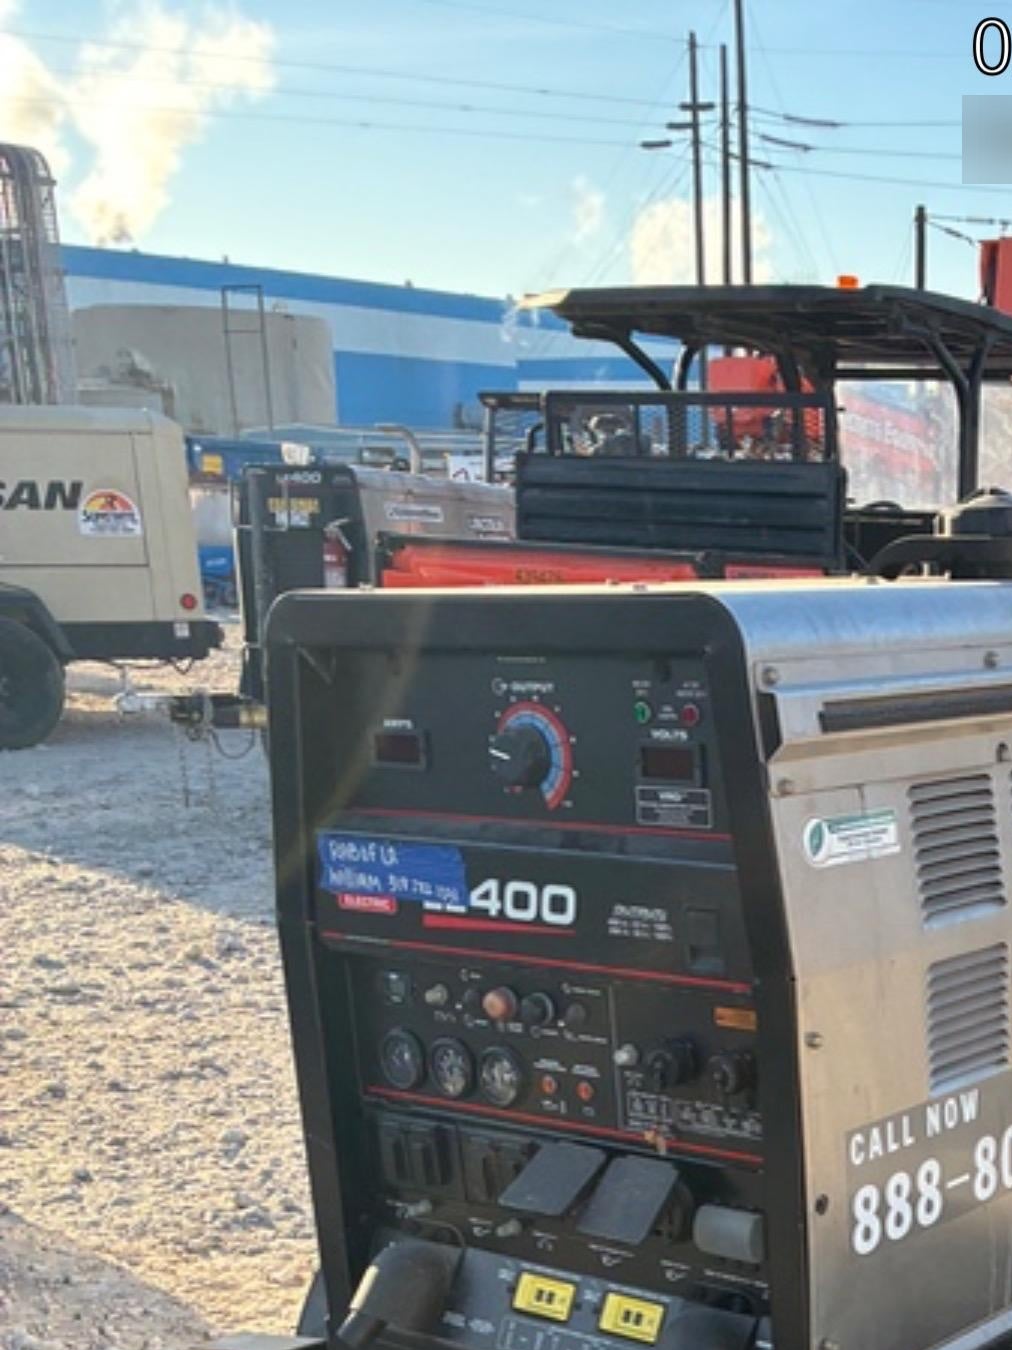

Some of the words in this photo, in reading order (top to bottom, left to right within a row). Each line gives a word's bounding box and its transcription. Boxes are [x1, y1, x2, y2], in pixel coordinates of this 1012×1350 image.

[423, 877, 578, 927] 400
[850, 1115, 915, 1166] CALL
[925, 1088, 980, 1138] NOW
